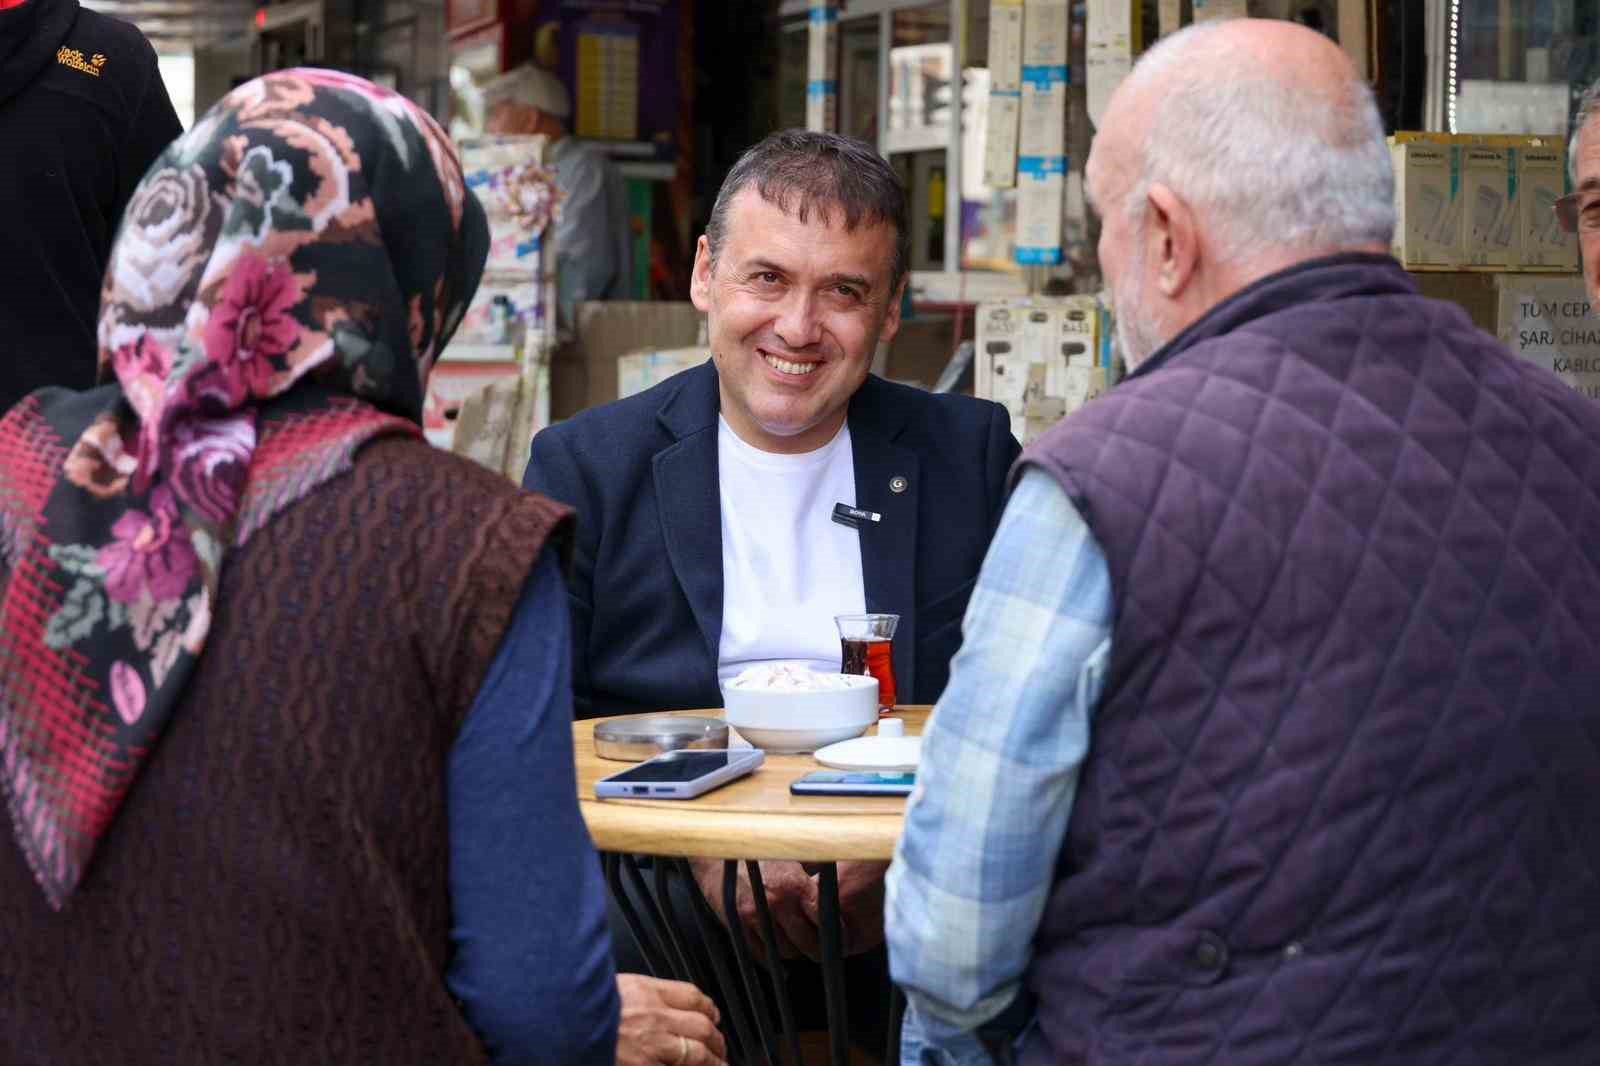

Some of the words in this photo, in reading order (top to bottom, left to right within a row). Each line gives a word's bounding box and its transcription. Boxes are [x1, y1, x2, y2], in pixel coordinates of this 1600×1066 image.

[57, 46, 84, 61] Jack
[58, 55, 100, 77] Wolfskin
[1562, 302, 1591, 317] CEP
